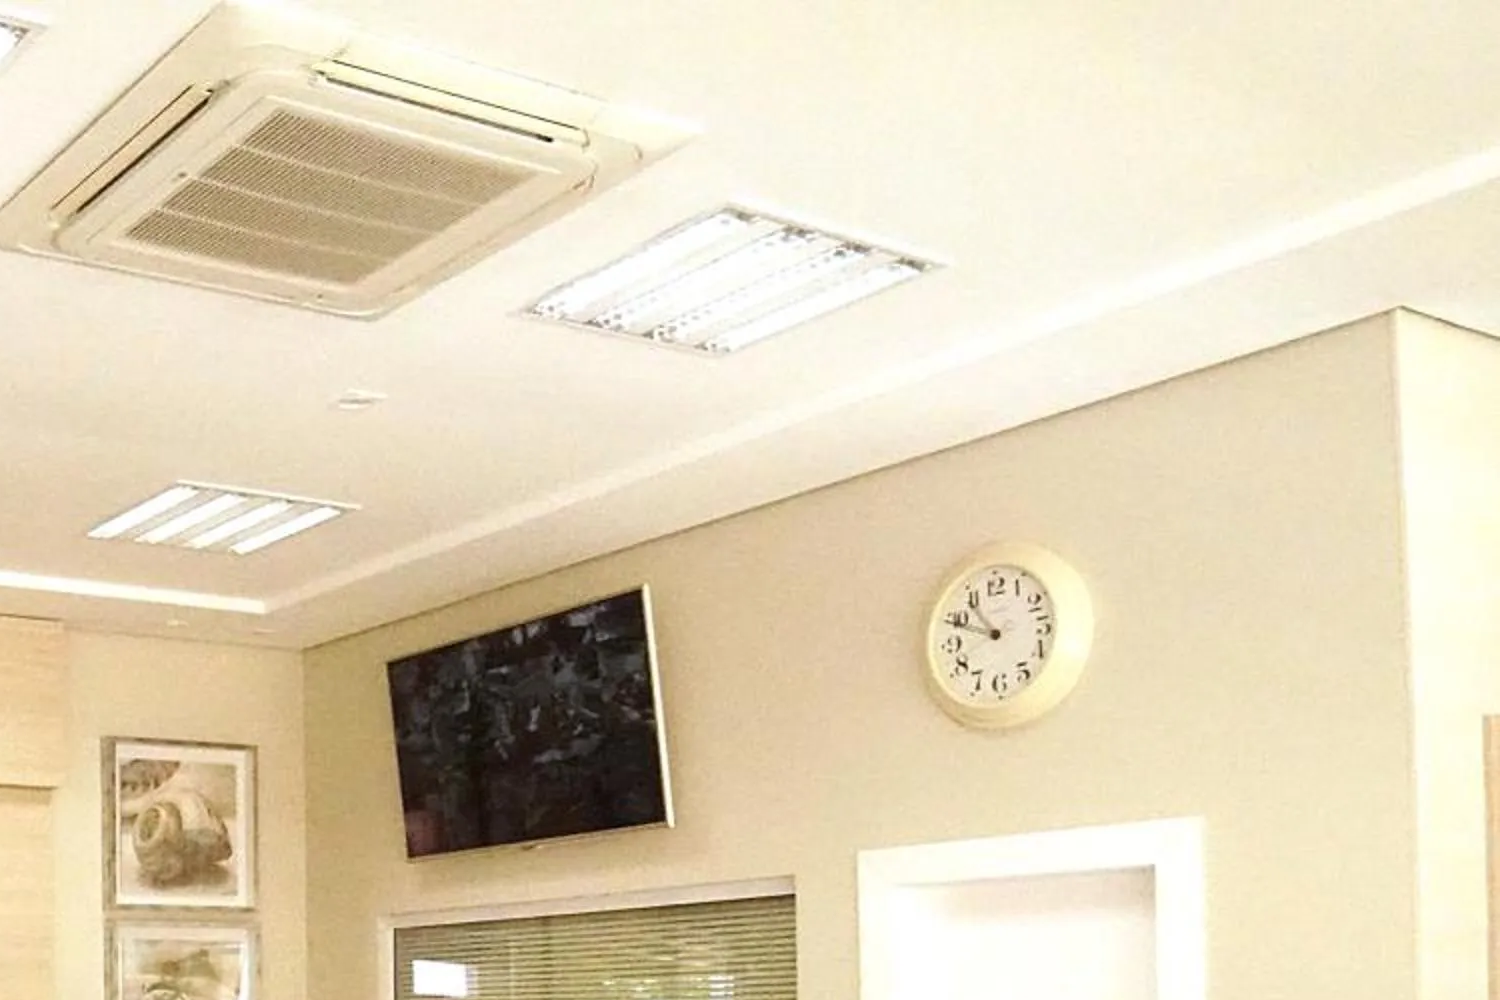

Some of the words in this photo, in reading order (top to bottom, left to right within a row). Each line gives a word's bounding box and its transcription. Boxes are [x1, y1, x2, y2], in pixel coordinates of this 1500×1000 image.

[987, 576, 1006, 596] 12
[1027, 592, 1043, 613] 2
[1035, 615, 1052, 636] 3
[946, 634, 963, 654] 9
[954, 652, 969, 676] 8
[1015, 661, 1031, 684] 5
[970, 669, 983, 691] 7
[991, 673, 1008, 692] 6
